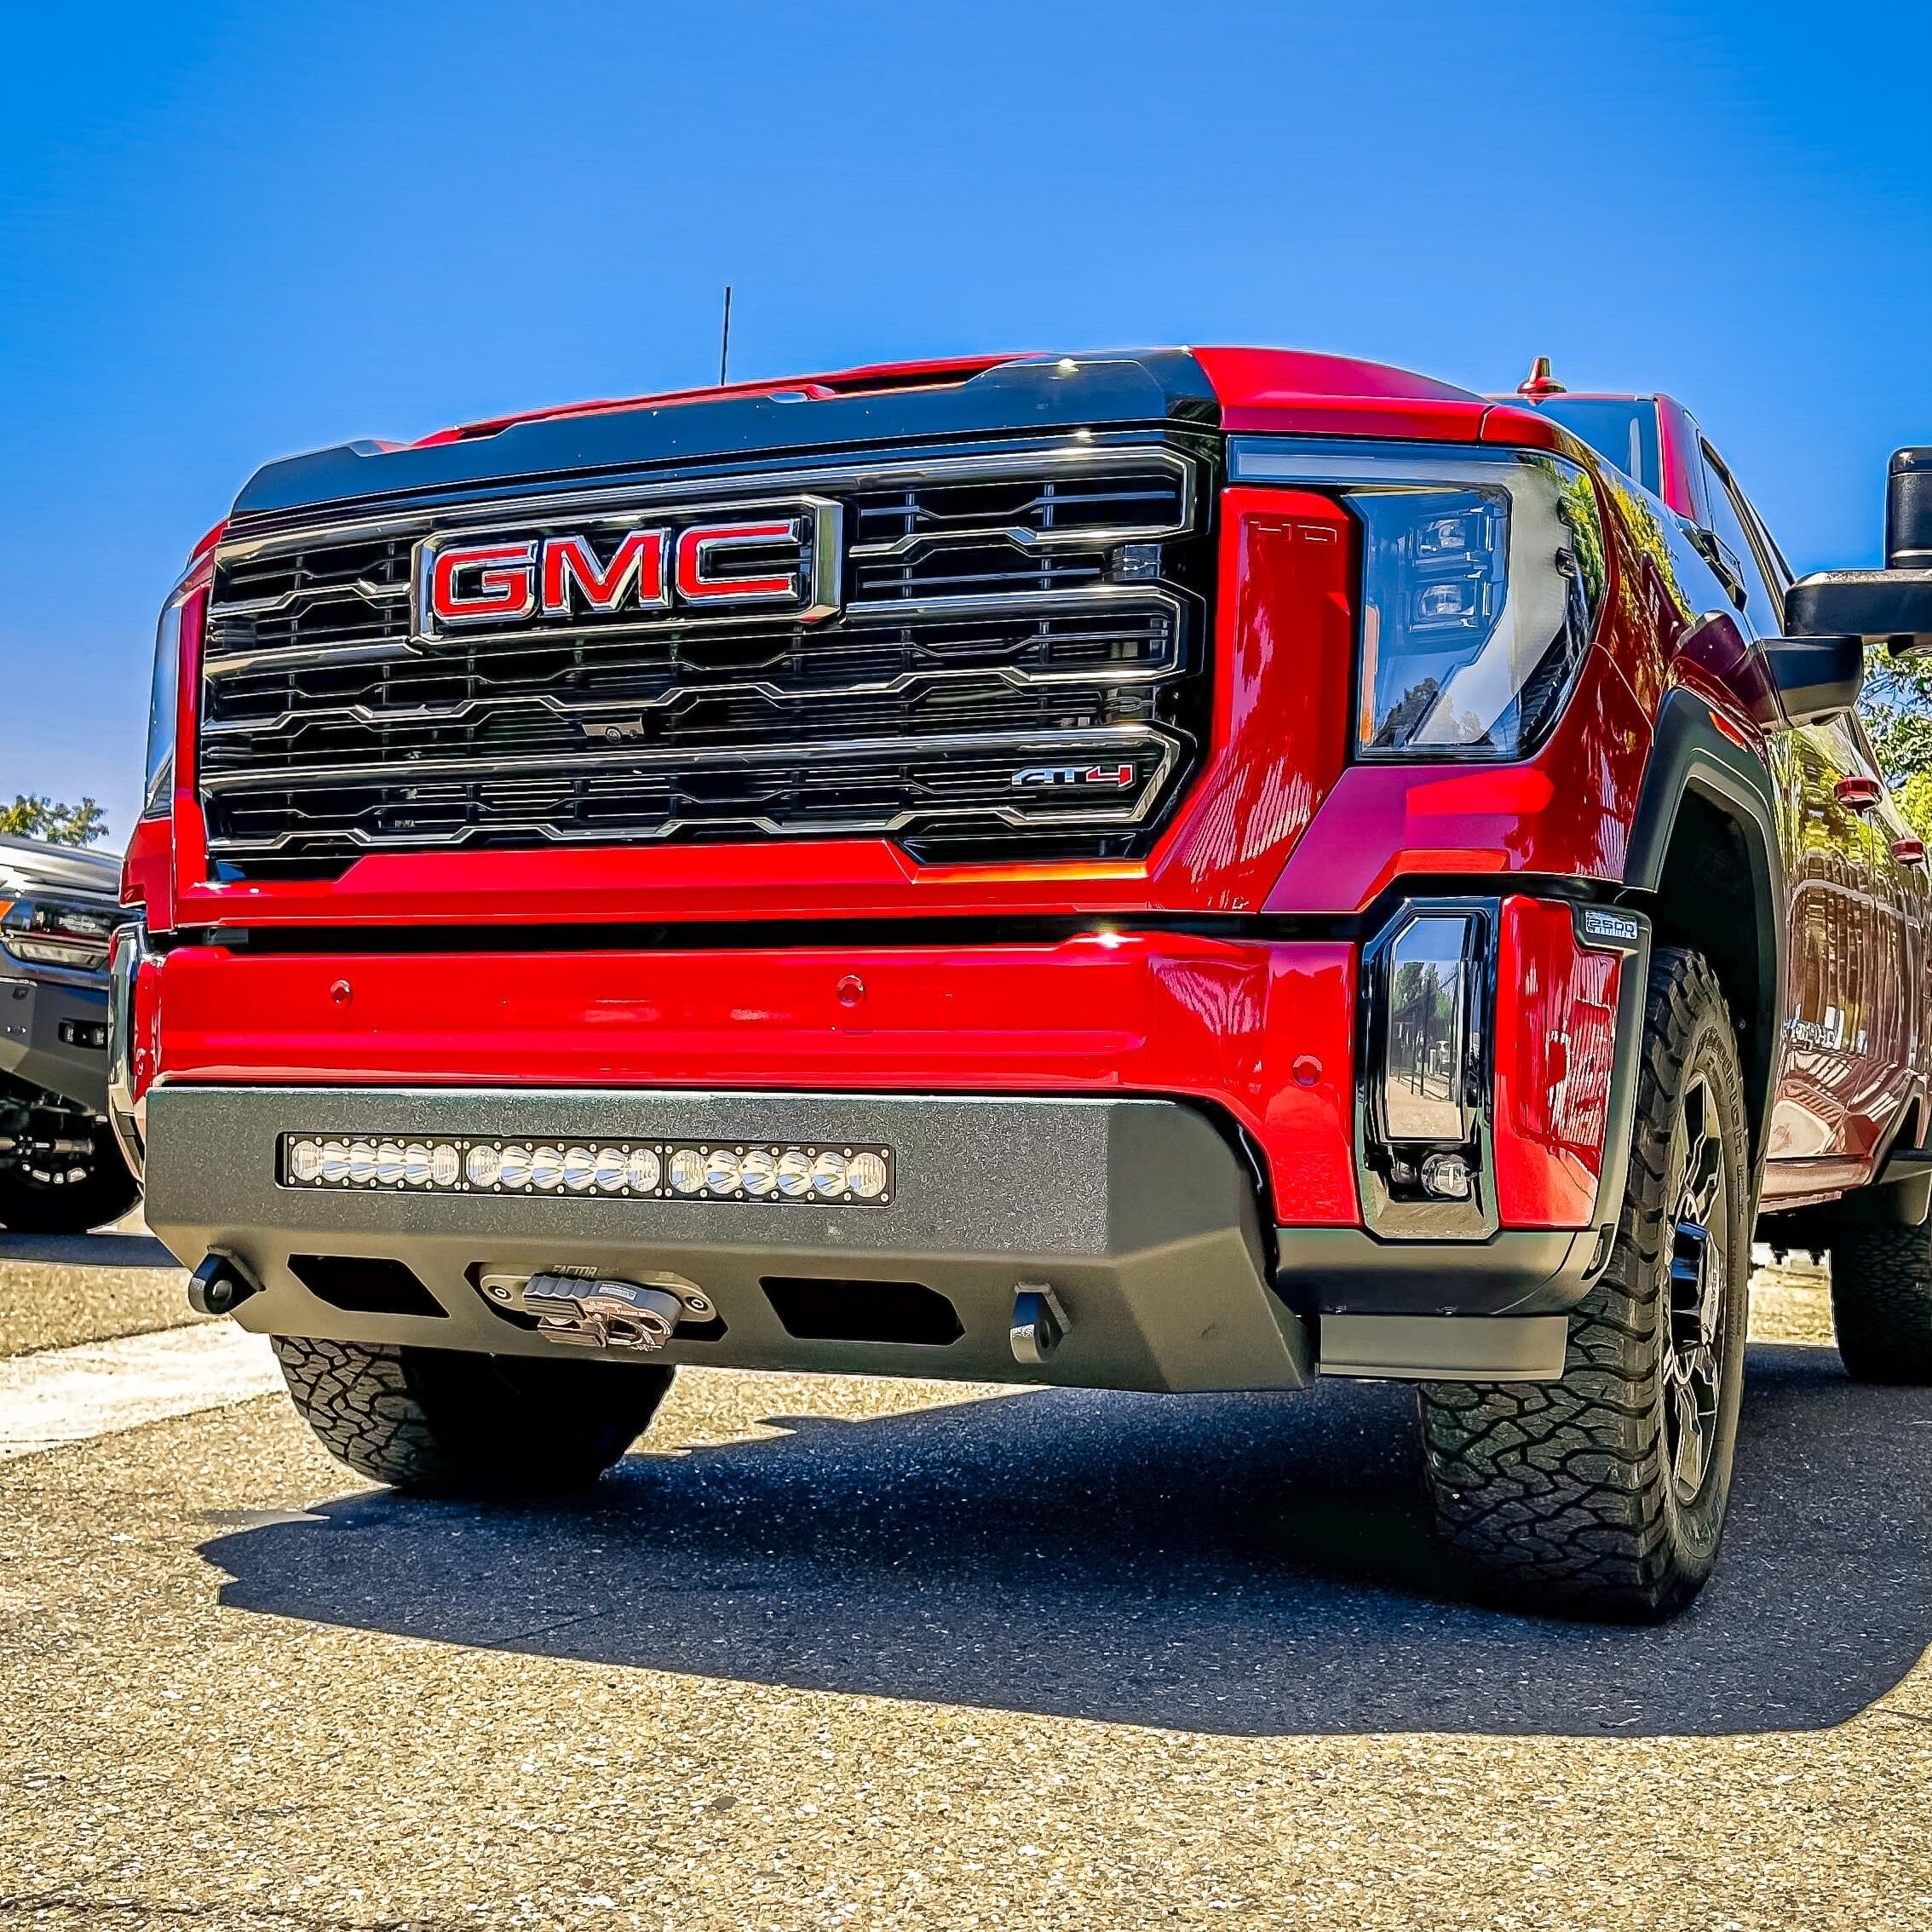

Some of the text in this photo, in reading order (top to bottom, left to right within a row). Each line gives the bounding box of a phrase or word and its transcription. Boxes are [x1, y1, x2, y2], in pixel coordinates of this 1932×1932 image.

[1249, 520, 1337, 544] HD
[433, 518, 803, 624] GMC
[1010, 763, 1134, 788] AT4
[552, 1264, 598, 1278] FACTOR
